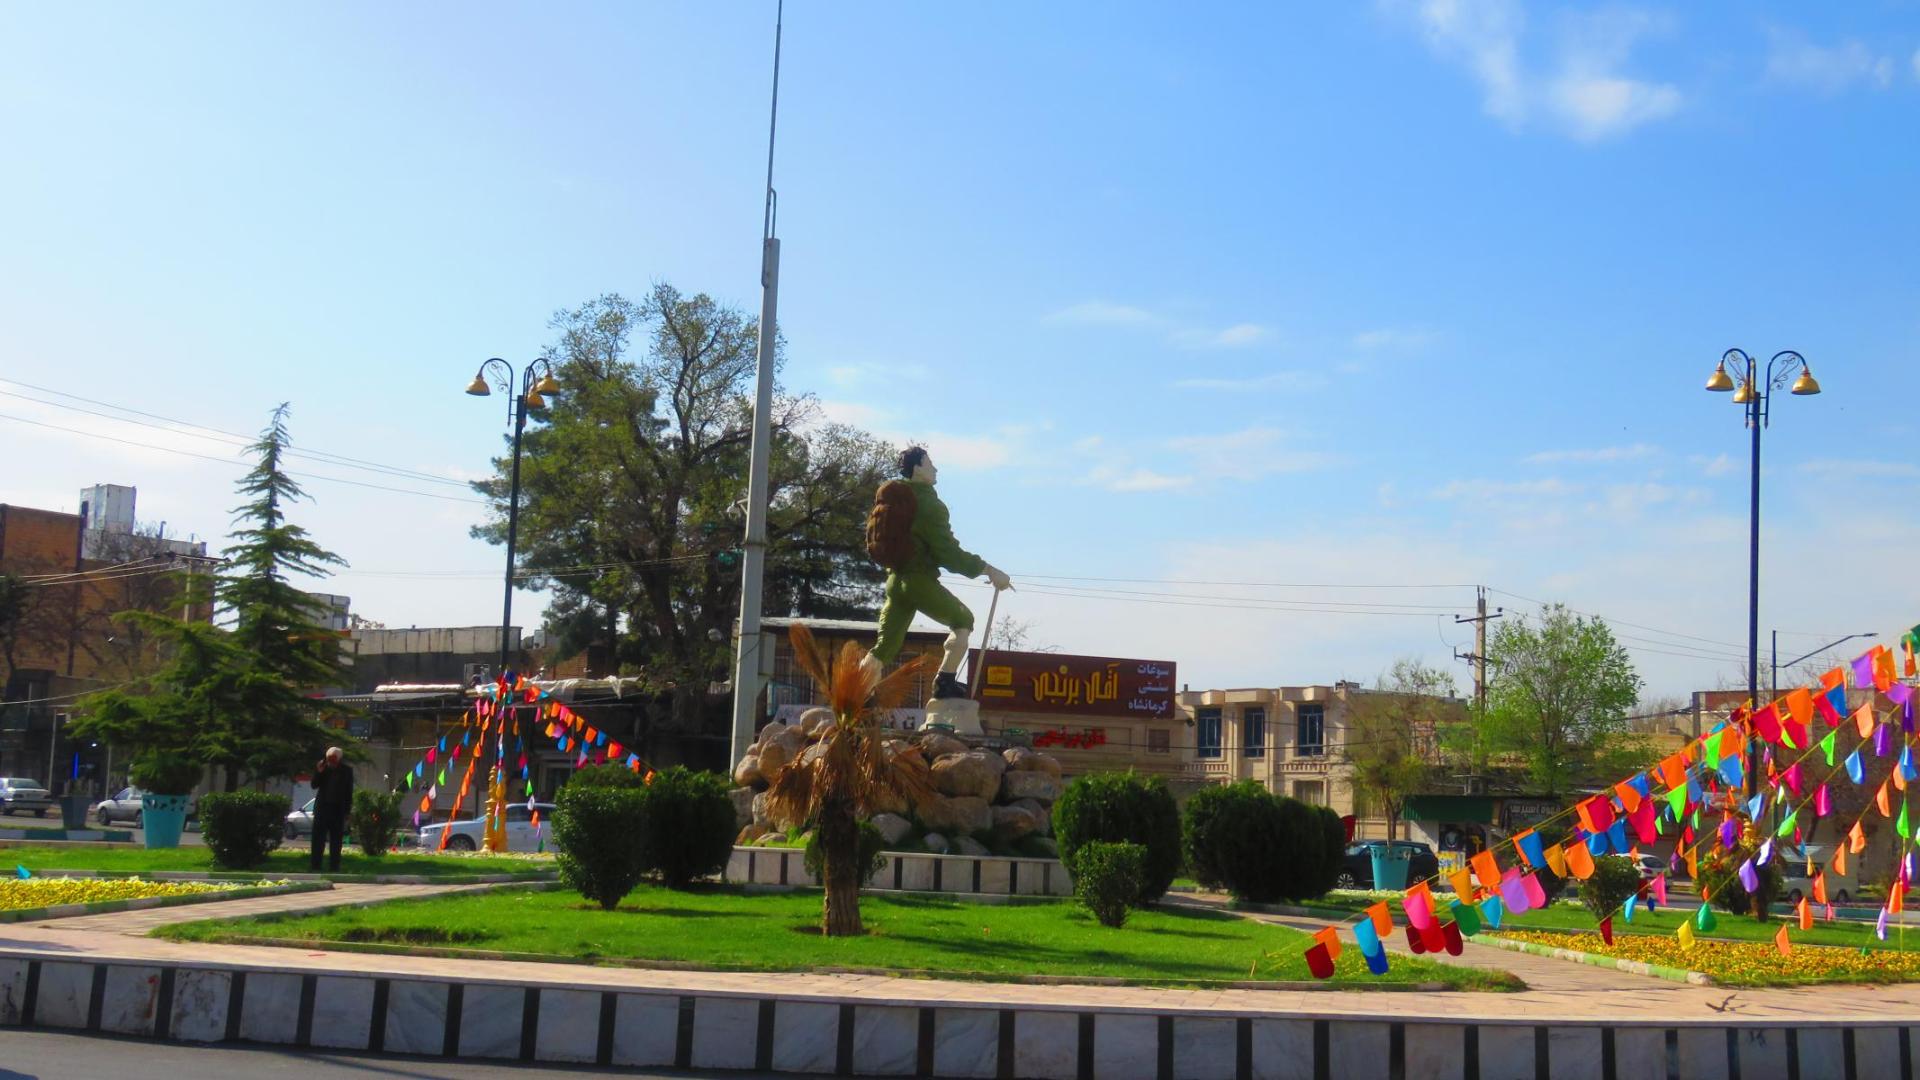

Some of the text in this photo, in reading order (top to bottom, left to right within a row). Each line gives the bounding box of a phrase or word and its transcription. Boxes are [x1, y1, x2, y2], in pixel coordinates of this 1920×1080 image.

[1136, 663, 1169, 679] سوغات
[1031, 664, 1080, 705] برنجی
[1138, 681, 1169, 694] سنتی
[1128, 698, 1169, 714] کرمانشاه
